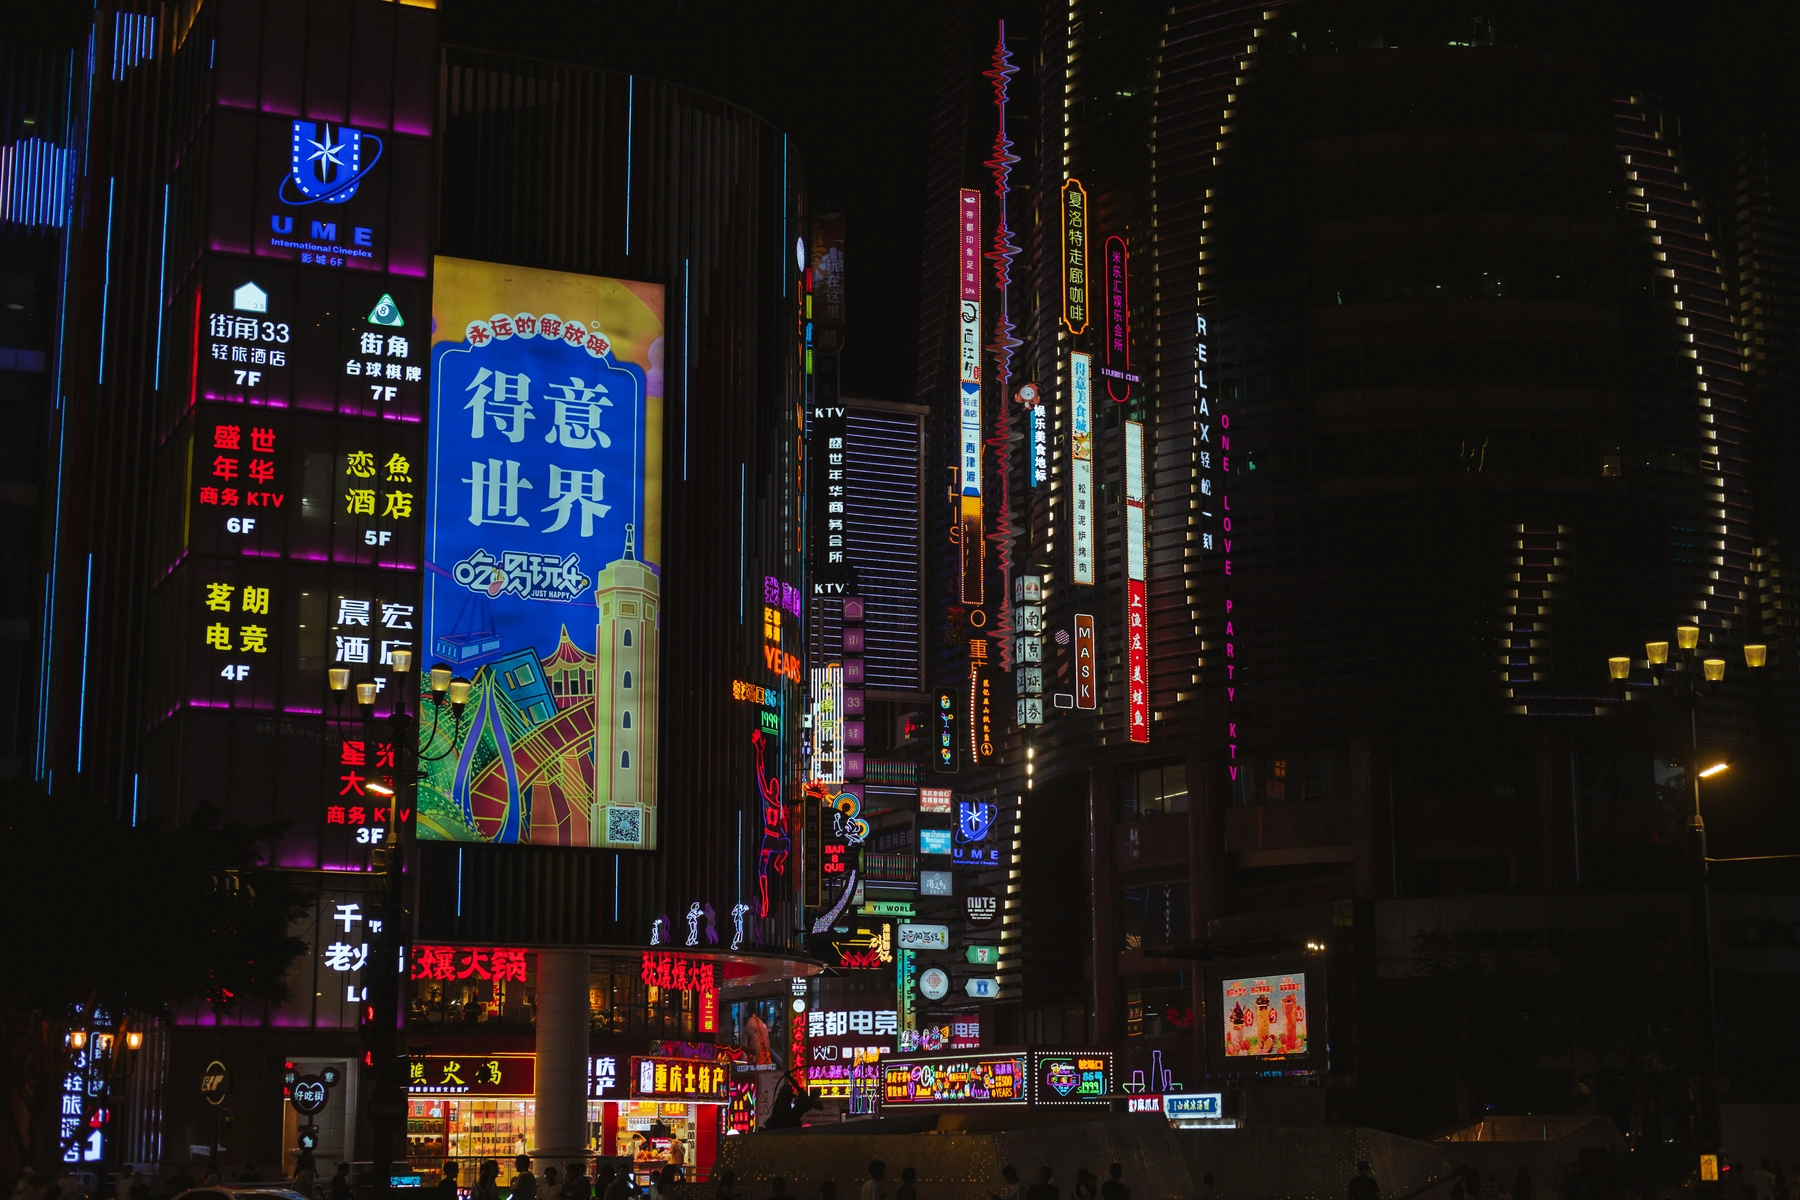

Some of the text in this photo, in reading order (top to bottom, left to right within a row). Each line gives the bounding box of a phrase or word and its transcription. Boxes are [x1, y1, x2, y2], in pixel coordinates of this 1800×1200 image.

[271, 238, 373, 259] International Cineplex
[965, 210, 975, 295] 帝都印象足道 SPA
[1068, 190, 1083, 322] 夏洛特走廊咖啡
[1112, 250, 1123, 352] 米乐汇娱乐会所
[209, 313, 290, 343] 街角33
[468, 315, 610, 355] 永远的解放碑
[211, 343, 286, 366] 轻旅酒店
[360, 332, 408, 358] 街角
[233, 370, 261, 386] 7F
[346, 360, 422, 382] 台球棋牌
[370, 385, 398, 402] 7F
[1075, 361, 1087, 433] 得意美食城
[463, 367, 614, 449] 得意
[815, 407, 845, 418] KTV
[962, 408, 978, 418] 酒店
[213, 425, 276, 453] 盛世
[1034, 404, 1047, 482] 娱乐美食地标
[1197, 316, 1213, 550] RELAX 轻松一刻
[212, 455, 275, 484] 年华
[346, 450, 413, 483] 恋魚
[200, 487, 284, 508] 商务 KTV
[345, 488, 414, 520] 酒店
[461, 458, 612, 537] 世界
[828, 437, 843, 563] 盛世年华商务会所
[226, 518, 256, 534] 6F
[364, 530, 392, 546] 5F
[205, 582, 270, 615] 茗朗
[531, 589, 570, 599] JUST HAPPY
[815, 583, 845, 594] KTV
[1221, 414, 1237, 781] ONE LOVE PARTY KTV
[337, 599, 414, 630] 晨宏
[206, 622, 268, 653] 电竞
[221, 665, 250, 681] 4F
[764, 644, 800, 684] YEARS
[1026, 611, 1041, 719] 南京证券
[1078, 627, 1091, 698] MASK
[762, 710, 778, 729] 1999
[327, 805, 366, 825] 商务
[356, 828, 384, 843] 3F
[824, 846, 845, 854] BAR
[954, 848, 999, 860] UME
[824, 863, 845, 873] QUE
[967, 896, 996, 909] NUTS
[808, 1010, 898, 1037] 雾都电竞
[655, 1064, 724, 1094] 重庆土特产
[1082, 1081, 1099, 1090] 1999
[294, 1090, 324, 1103] 好吃街
[996, 1087, 1013, 1098] YEARS
